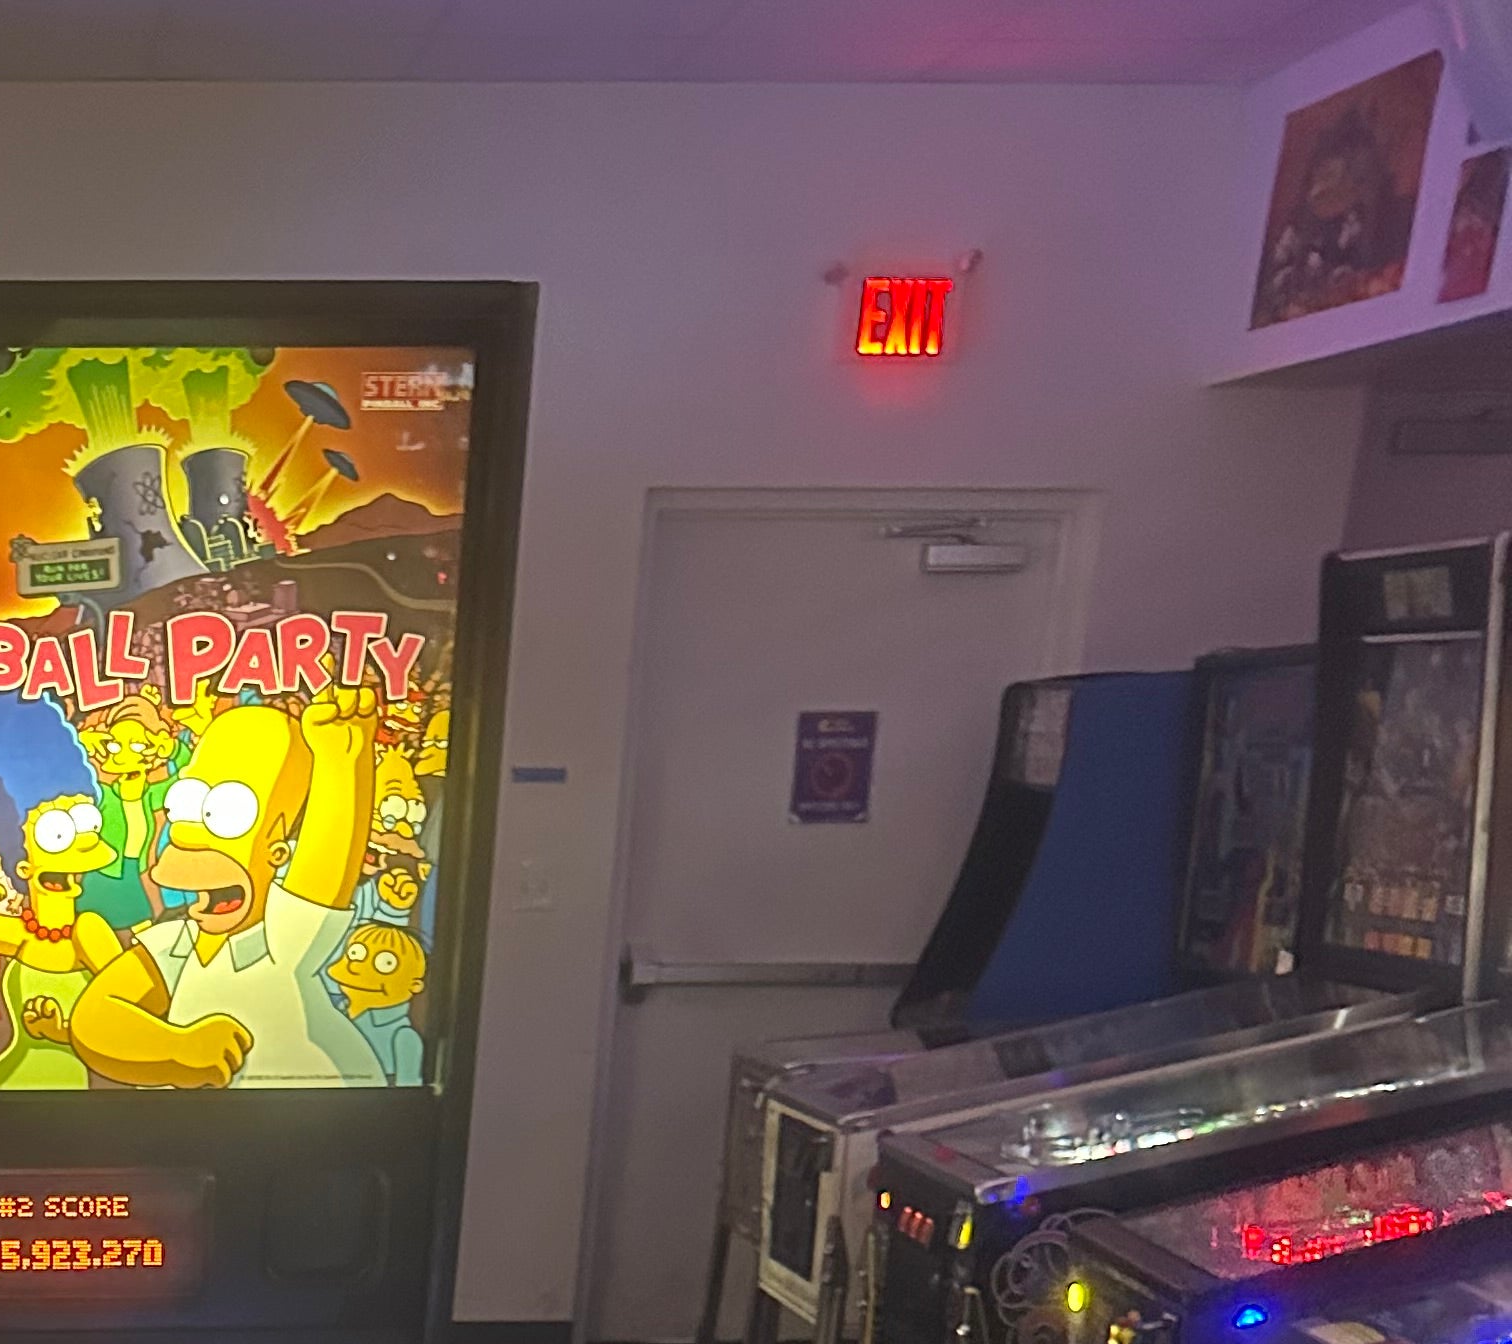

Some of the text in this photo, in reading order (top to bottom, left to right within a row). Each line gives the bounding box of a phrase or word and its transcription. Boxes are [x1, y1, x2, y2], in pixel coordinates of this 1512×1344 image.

[857, 278, 953, 355] EXIT
[166, 610, 425, 706] PARTY
[43, 1195, 130, 1218] SCORE
